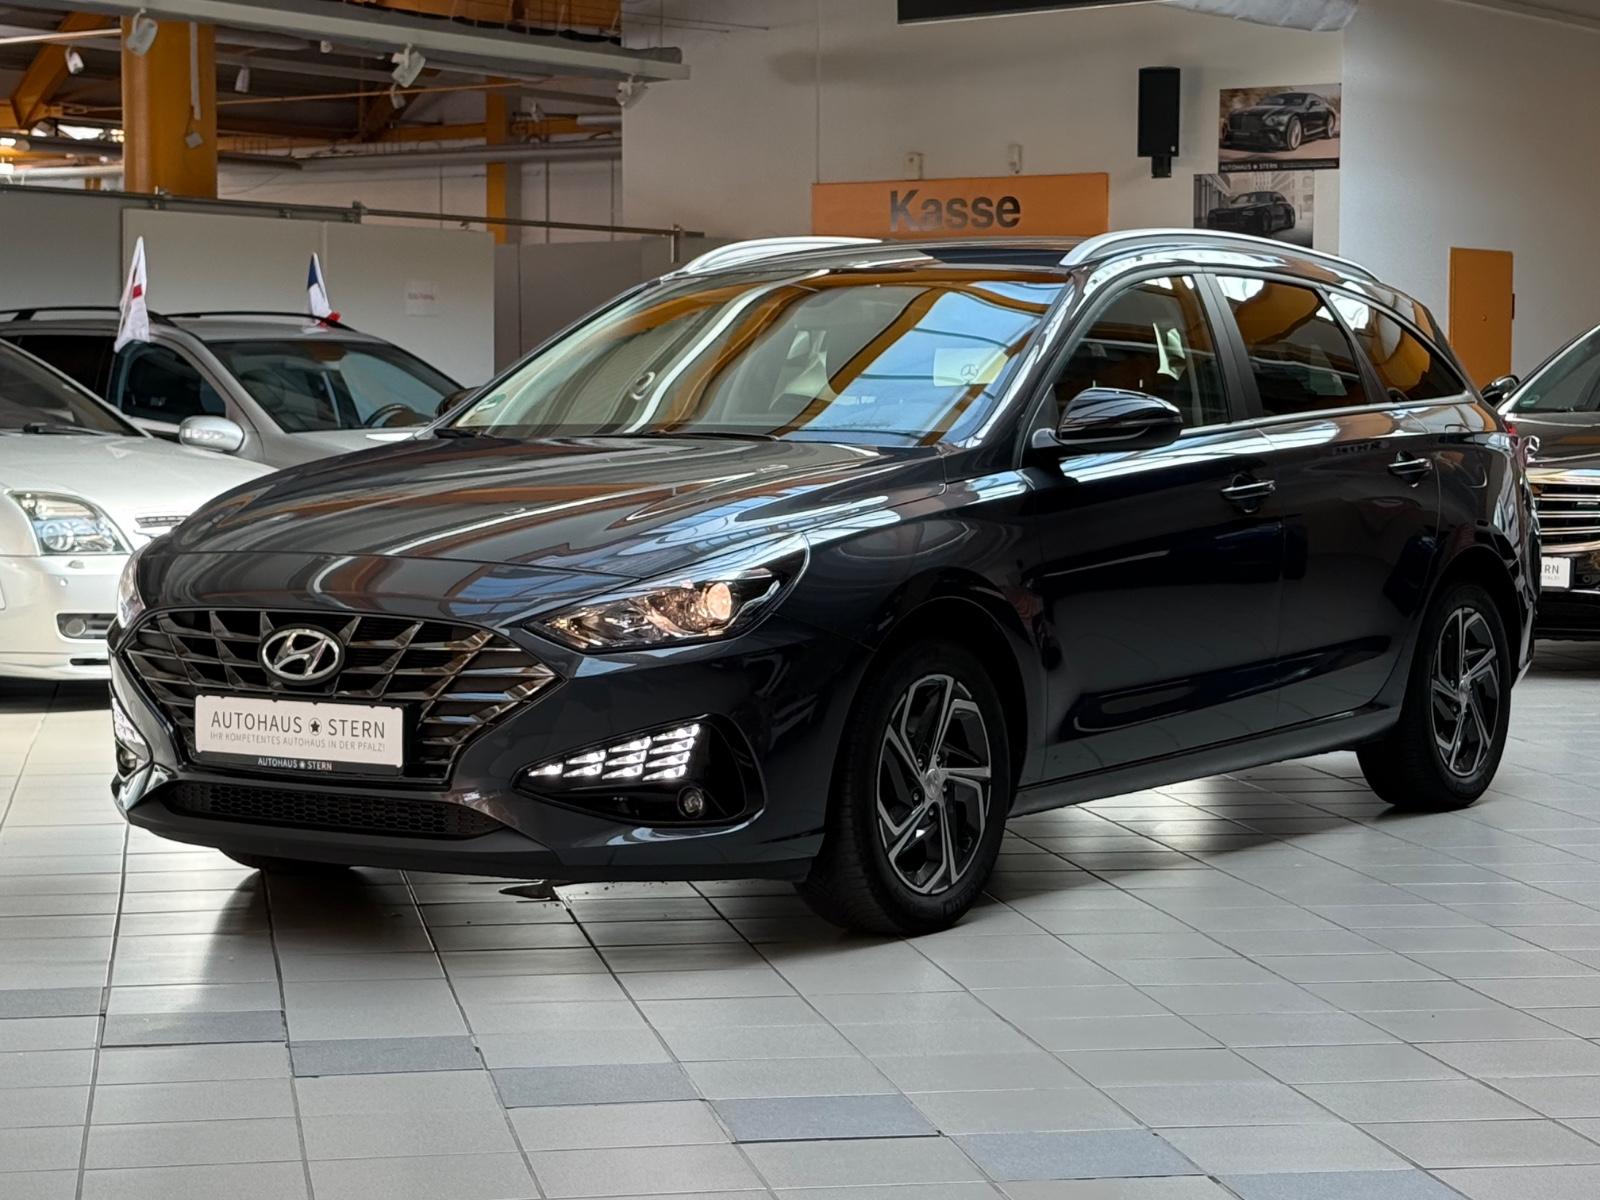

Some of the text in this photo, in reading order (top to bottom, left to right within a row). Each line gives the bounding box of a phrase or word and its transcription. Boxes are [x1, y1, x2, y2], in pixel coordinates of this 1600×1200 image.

[889, 189, 1021, 232] Kasse
[211, 711, 385, 739] AUTOHAUS STERN
[210, 731, 386, 753] IHR KOMPETENTES AUTOHAUS IN DER PFALZ!
[257, 757, 333, 771] AUTOHAUS STERN
